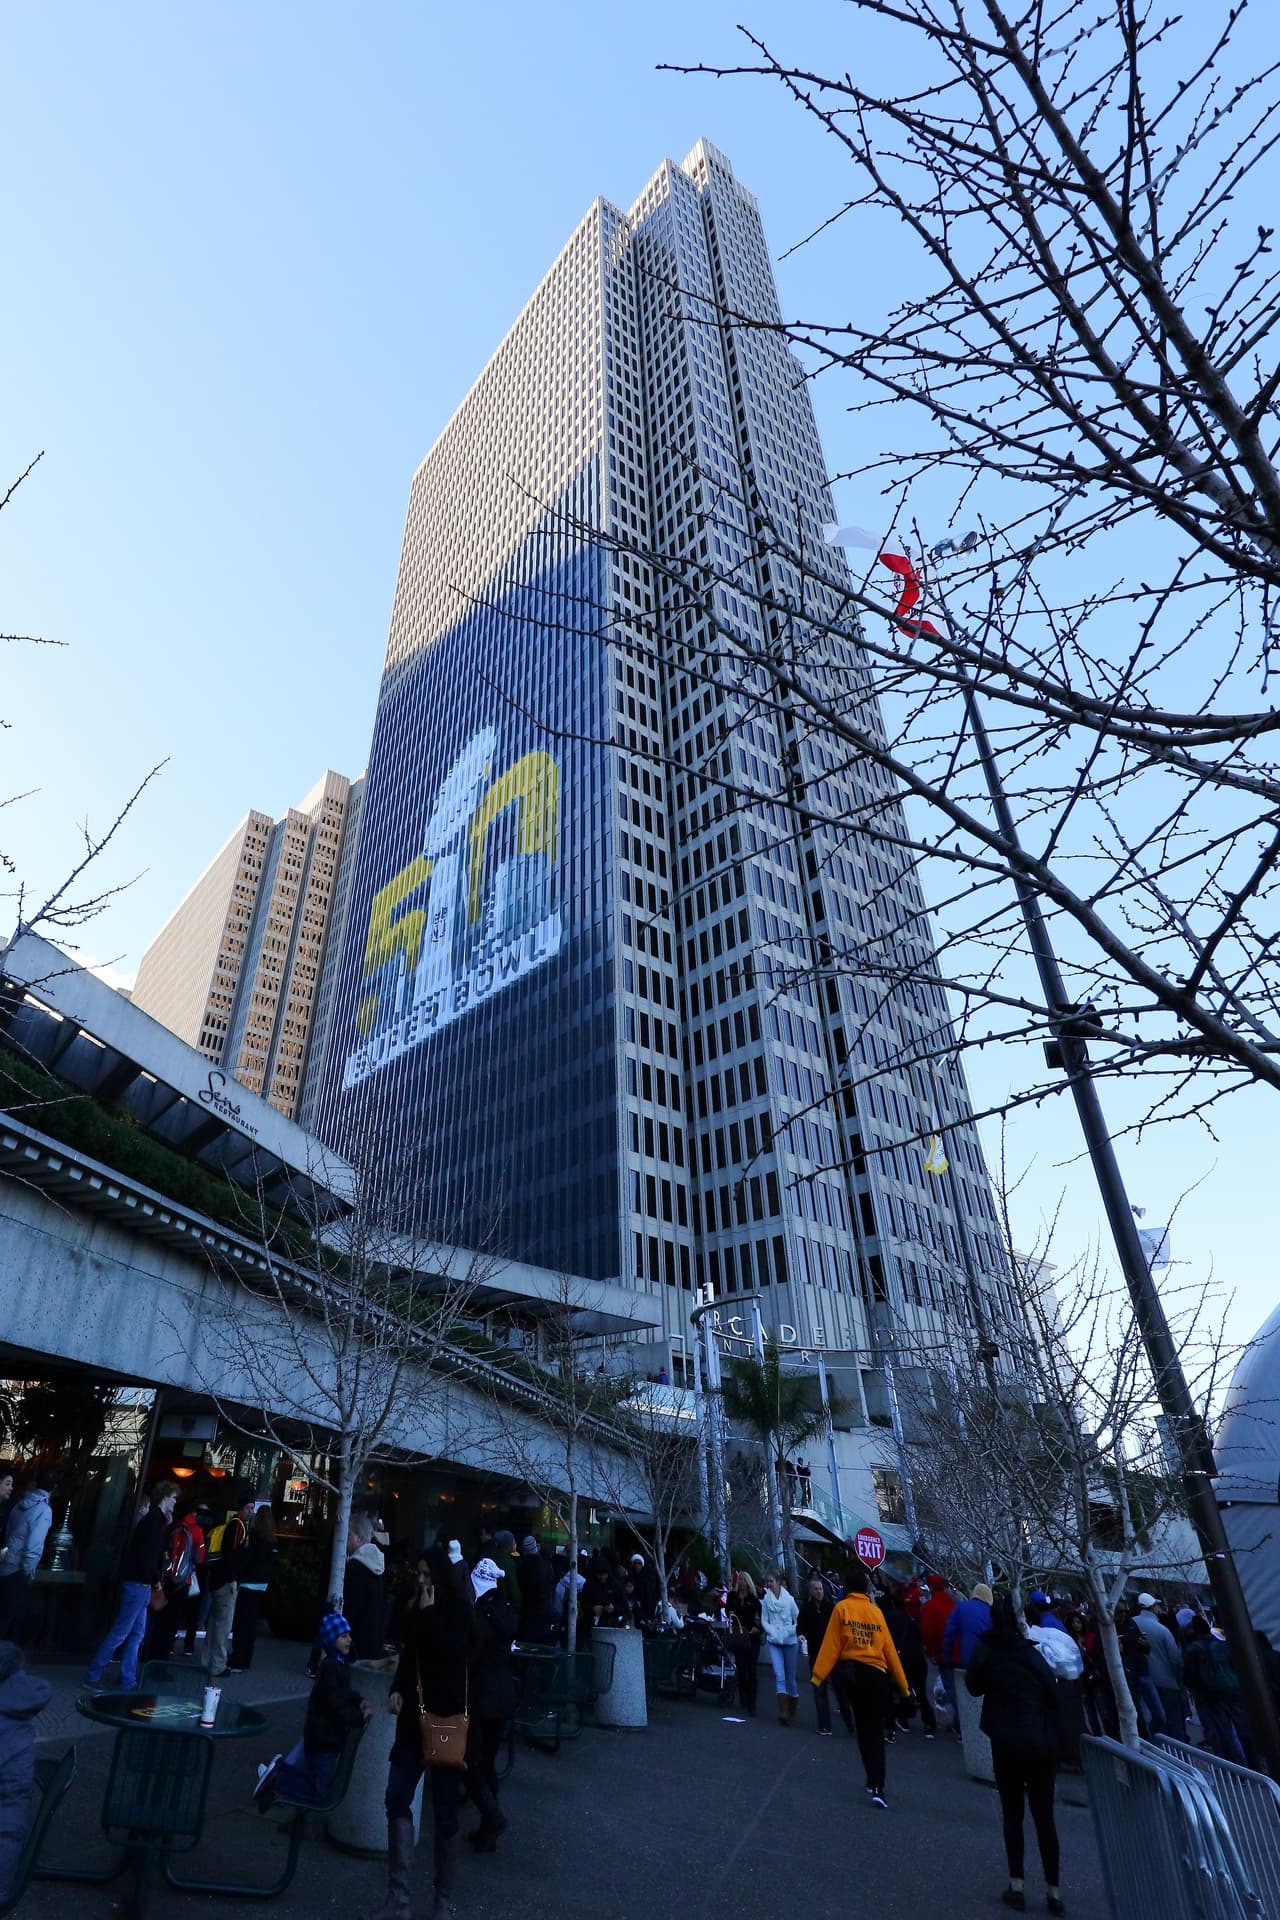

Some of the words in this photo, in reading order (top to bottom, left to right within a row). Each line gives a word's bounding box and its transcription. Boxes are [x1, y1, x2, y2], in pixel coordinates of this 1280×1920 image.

[453, 931, 547, 1013] BOWL
[213, 1101, 259, 1136] RESTAURANT
[857, 1533, 881, 1544] EMERGENCY
[858, 1541, 881, 1559] EXIT
[844, 1619, 882, 1632] LANDMARK
[851, 1628, 874, 1639] EVENT
[852, 1636, 875, 1647] STAFF
